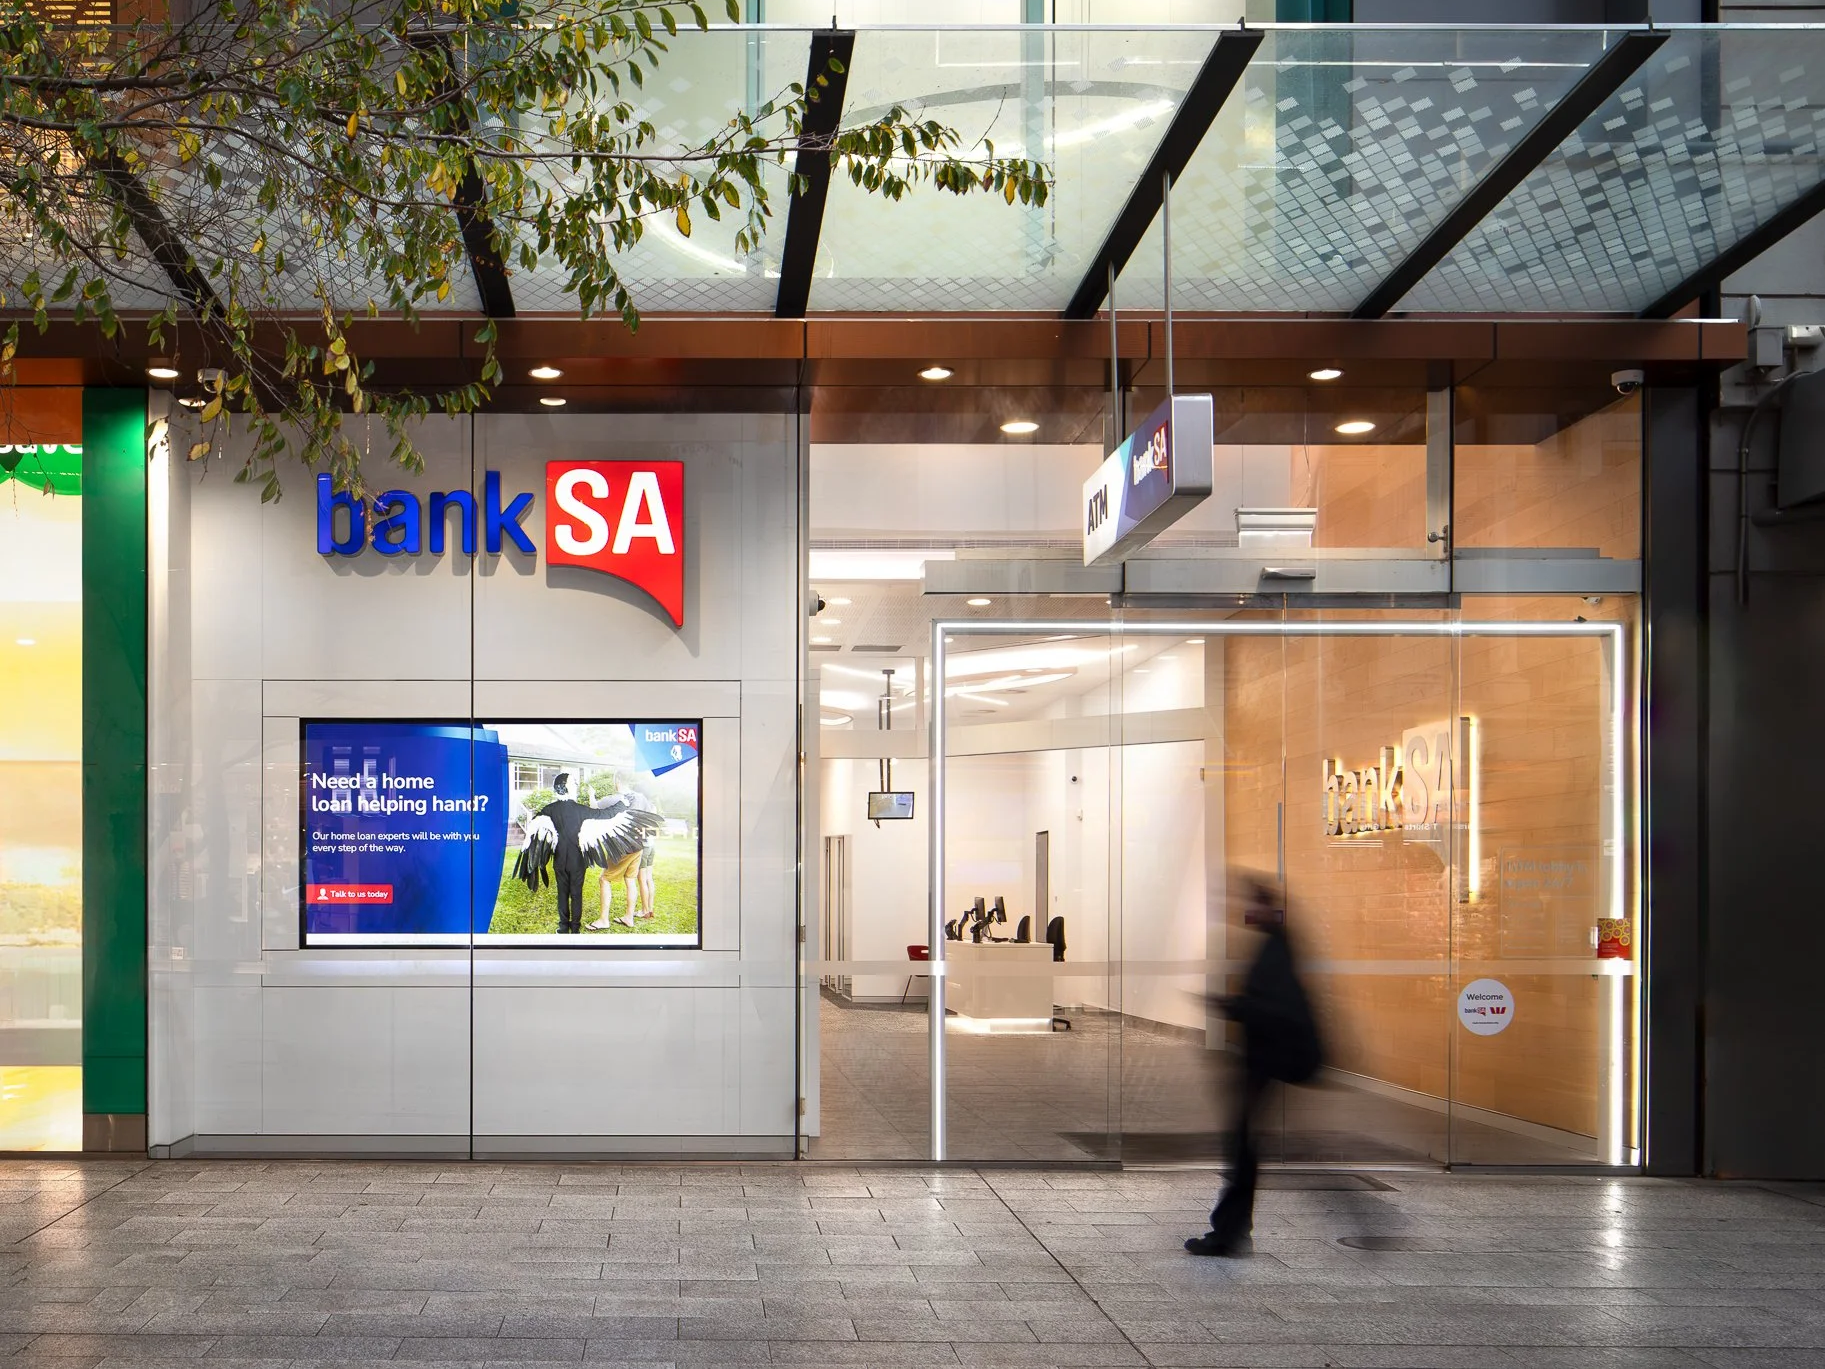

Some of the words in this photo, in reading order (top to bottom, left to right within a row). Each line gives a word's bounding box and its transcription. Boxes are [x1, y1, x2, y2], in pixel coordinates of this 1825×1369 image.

[1087, 483, 1108, 536] ATM
[311, 772, 360, 789] Need
[365, 777, 377, 789] a
[382, 772, 435, 789] home
[311, 795, 352, 812] loan
[357, 795, 427, 815] helping
[432, 795, 489, 812] hand?
[312, 831, 329, 841] Our
[330, 831, 356, 841] home
[357, 831, 376, 841] loan
[377, 832, 410, 843] experts
[411, 831, 428, 841] will
[429, 831, 441, 841] be
[442, 831, 462, 841] with
[463, 833, 480, 843] you
[312, 844, 335, 853] every
[337, 843, 357, 854] step
[358, 843, 369, 853] of
[369, 843, 384, 853] the
[384, 844, 406, 854] way.
[330, 890, 347, 898] Talk
[347, 890, 356, 898] to
[367, 890, 389, 900] today
[1466, 993, 1504, 1001] Welcome
